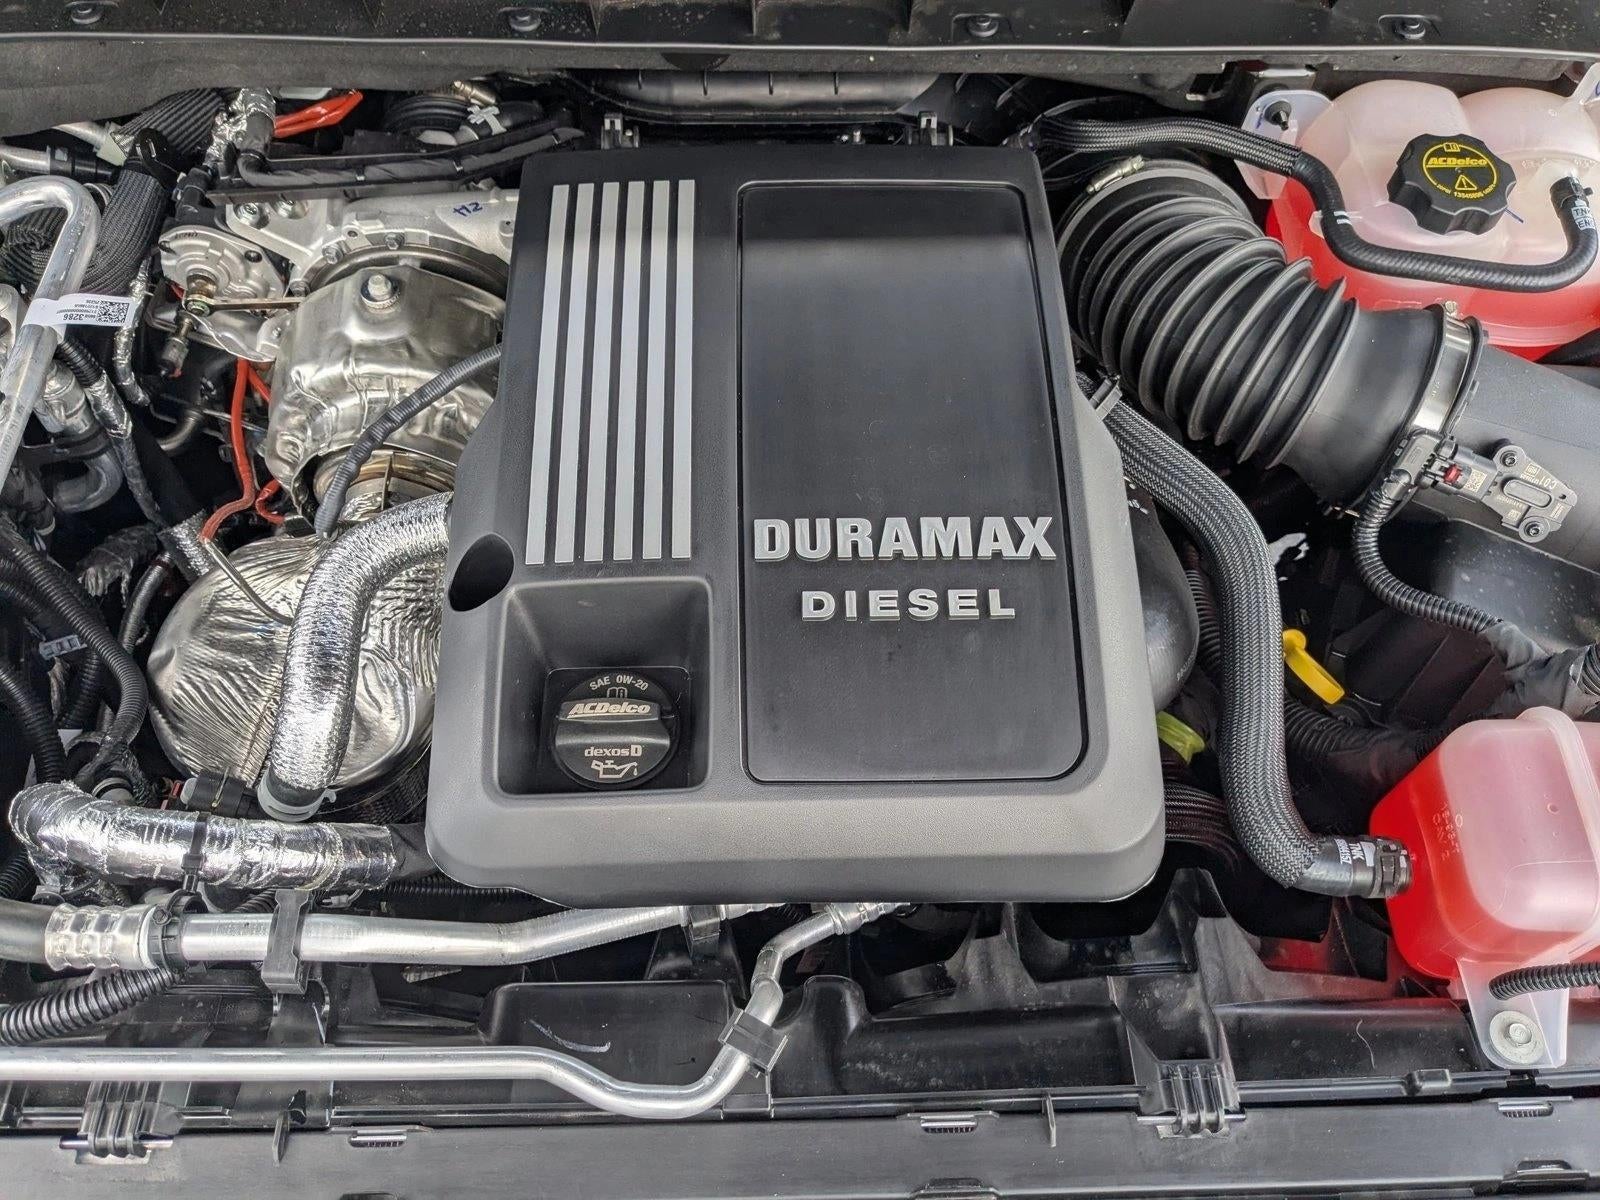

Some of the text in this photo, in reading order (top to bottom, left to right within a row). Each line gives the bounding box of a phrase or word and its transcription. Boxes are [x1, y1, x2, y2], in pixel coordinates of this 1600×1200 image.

[1426, 157, 1488, 167] ACDelco
[63, 312, 85, 321] 3286
[753, 516, 1057, 562] DURAMAX
[801, 588, 1016, 622] DIESEL
[589, 674, 649, 691] SAE 0W-20
[567, 701, 651, 717] ACDelco
[584, 744, 643, 757] dexosD
[1348, 842, 1365, 860] TNK
